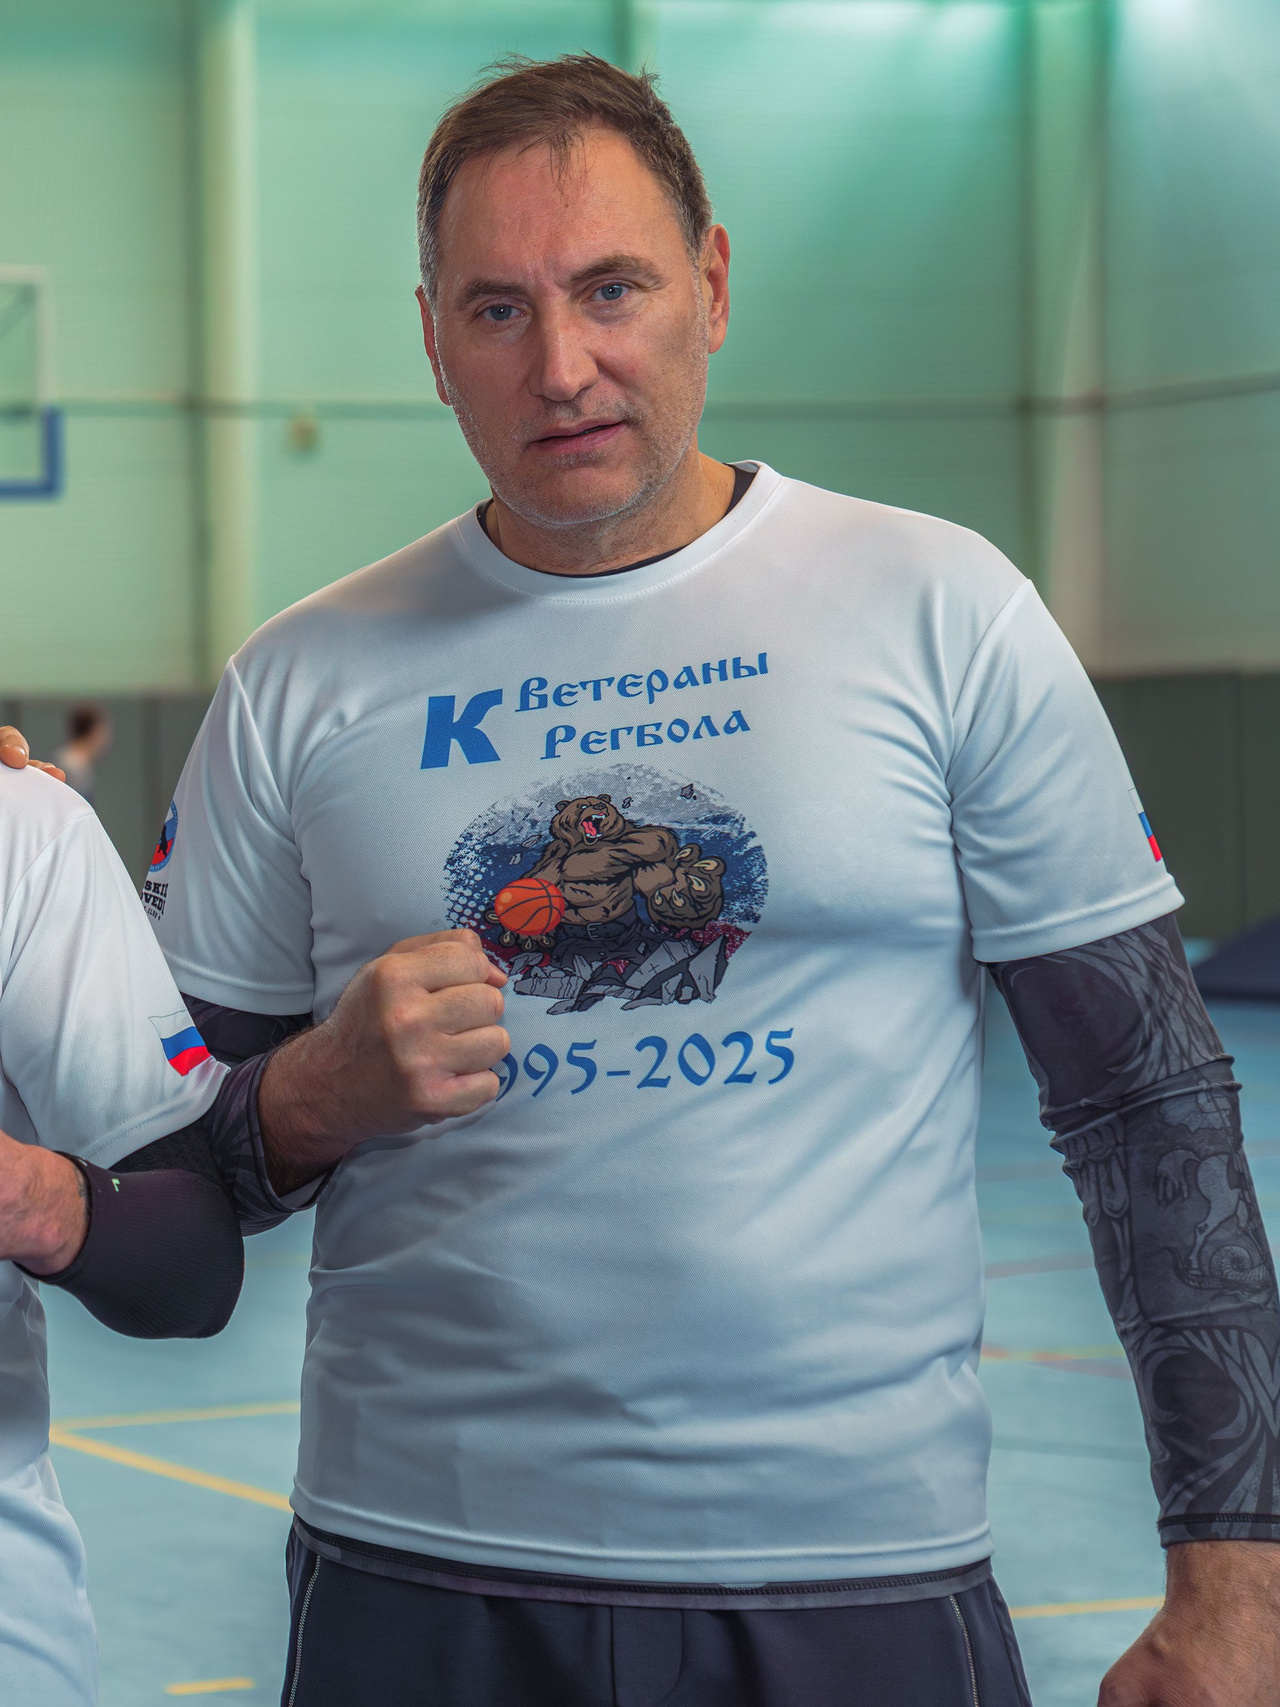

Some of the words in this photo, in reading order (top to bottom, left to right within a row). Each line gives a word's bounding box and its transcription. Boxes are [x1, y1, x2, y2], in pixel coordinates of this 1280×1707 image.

[514, 652, 769, 713] Ветераны
[420, 688, 503, 770] К
[540, 709, 751, 760] Регбола
[488, 1028, 795, 1102] 995-2025
